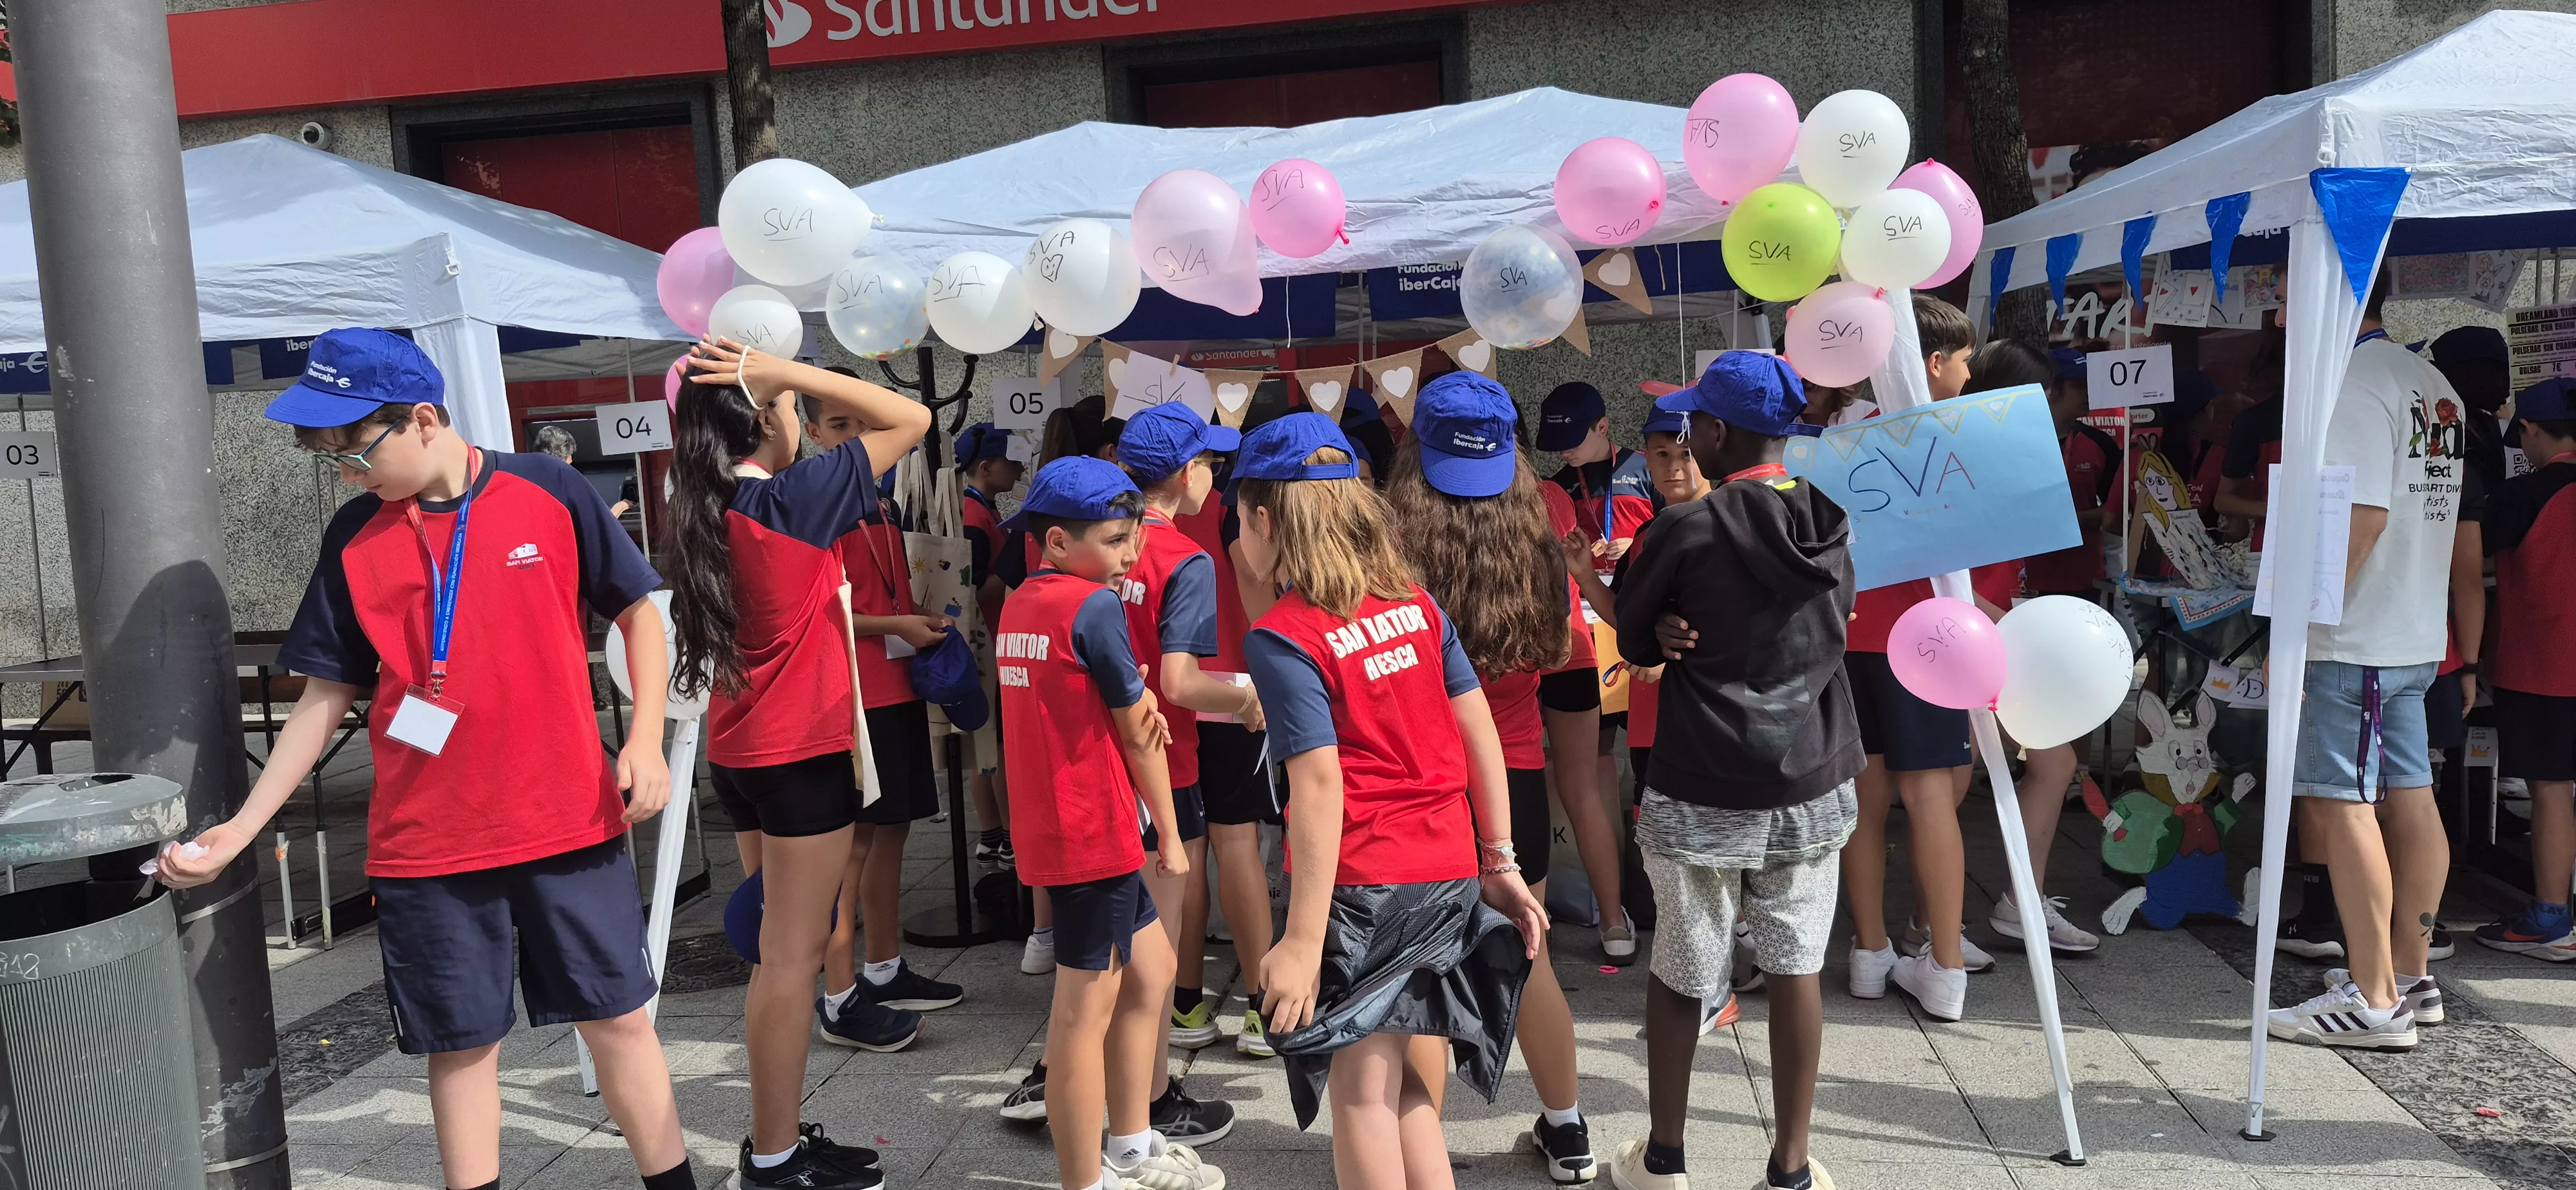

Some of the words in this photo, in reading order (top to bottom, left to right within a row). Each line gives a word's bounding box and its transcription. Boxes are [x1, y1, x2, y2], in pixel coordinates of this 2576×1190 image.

[1839, 131, 1877, 153] SVA
[1260, 167, 1305, 202] SVA
[763, 207, 814, 237] SVA
[1595, 218, 1641, 240] SVA
[1884, 214, 1923, 238] SVA
[1029, 229, 1076, 263] SVA
[1748, 240, 1792, 261] SVA
[1152, 242, 1210, 279] SVA
[835, 269, 884, 305] SVA
[932, 264, 986, 296] SVA
[1499, 267, 1528, 288] SVA
[735, 323, 778, 348] SVA
[1818, 319, 1863, 343] SVA
[2511, 323, 2539, 335] PULSERAS
[286, 337, 319, 352] iber
[1206, 349, 1264, 361] Santander
[2513, 344, 2541, 355] PULSERAS
[310, 361, 337, 375] Fundación
[2110, 359, 2146, 386] 07
[1009, 392, 1045, 416] 05
[616, 416, 652, 439] 04
[1454, 431, 1486, 443] Fundación
[6, 444, 40, 466] 03
[1453, 438, 1484, 451] Ibercaja
[1848, 435, 1976, 513] SVA
[2446, 484, 2462, 493] DIV
[1006, 632, 1050, 661] VIATOR
[1325, 621, 1370, 659] SAN
[1916, 616, 1967, 663] SVA
